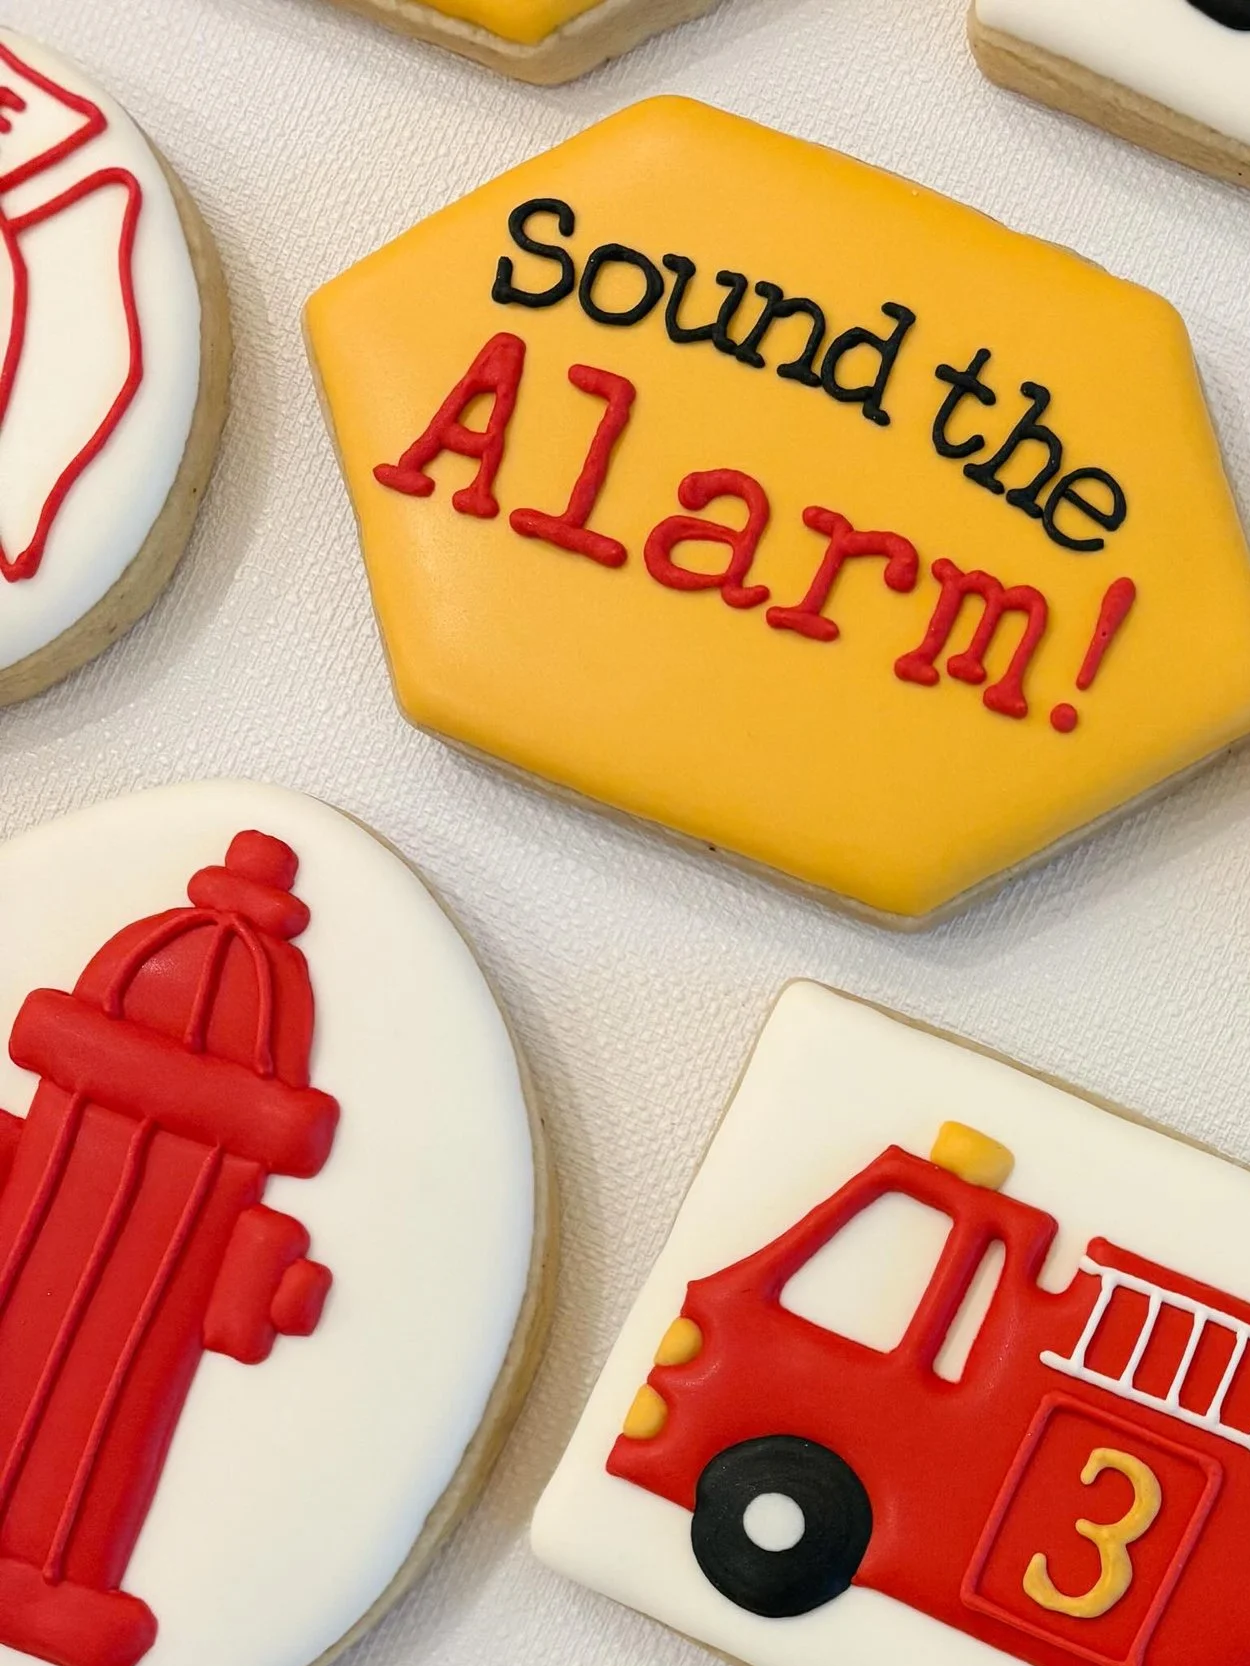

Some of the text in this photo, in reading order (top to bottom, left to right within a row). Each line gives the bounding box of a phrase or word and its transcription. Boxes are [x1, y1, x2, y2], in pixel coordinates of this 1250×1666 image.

[373, 331, 1136, 733] Alarm!
[492, 198, 1127, 552] Sound the
[1022, 1447, 1162, 1618] 3
